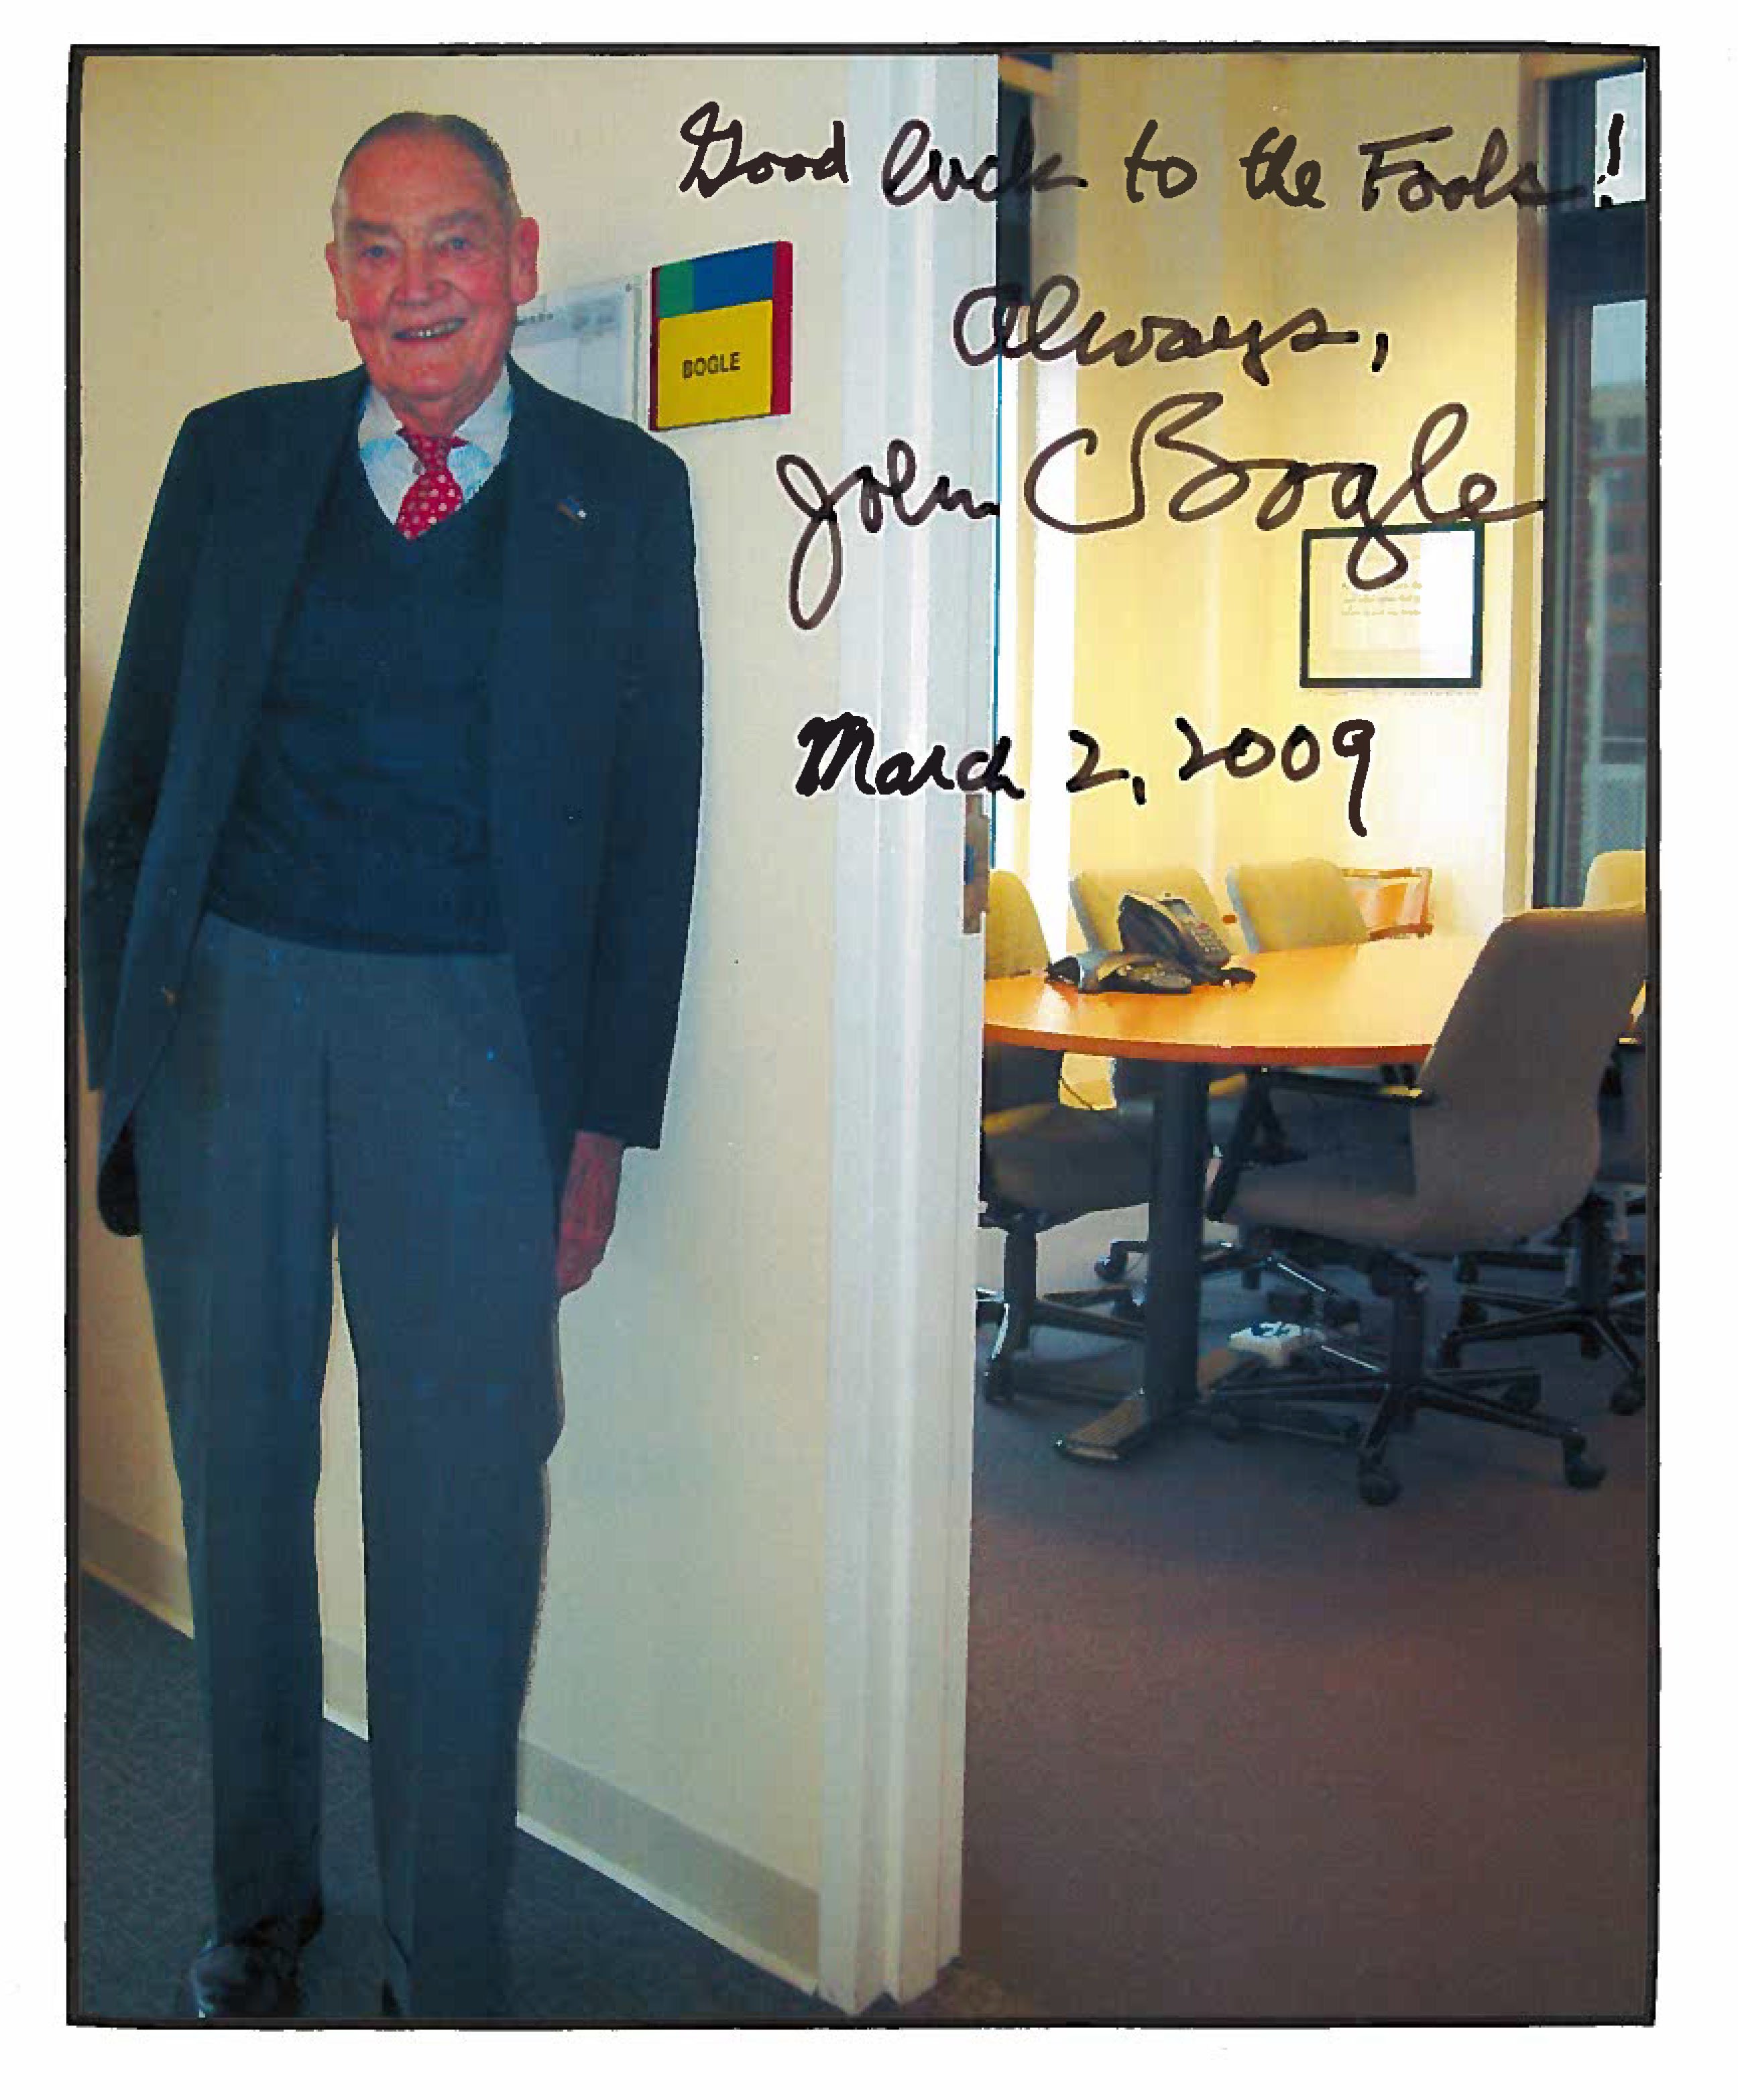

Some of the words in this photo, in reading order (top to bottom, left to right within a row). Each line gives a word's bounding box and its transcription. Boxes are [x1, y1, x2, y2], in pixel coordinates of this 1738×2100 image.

[679, 101, 850, 198] Good
[881, 117, 1088, 205] luck
[1124, 119, 1198, 203] to
[1238, 126, 1326, 209] the
[681, 351, 742, 380] BOGLE
[776, 439, 999, 630] John
[797, 711, 1025, 797] March
[1175, 717, 1376, 837] 2009
